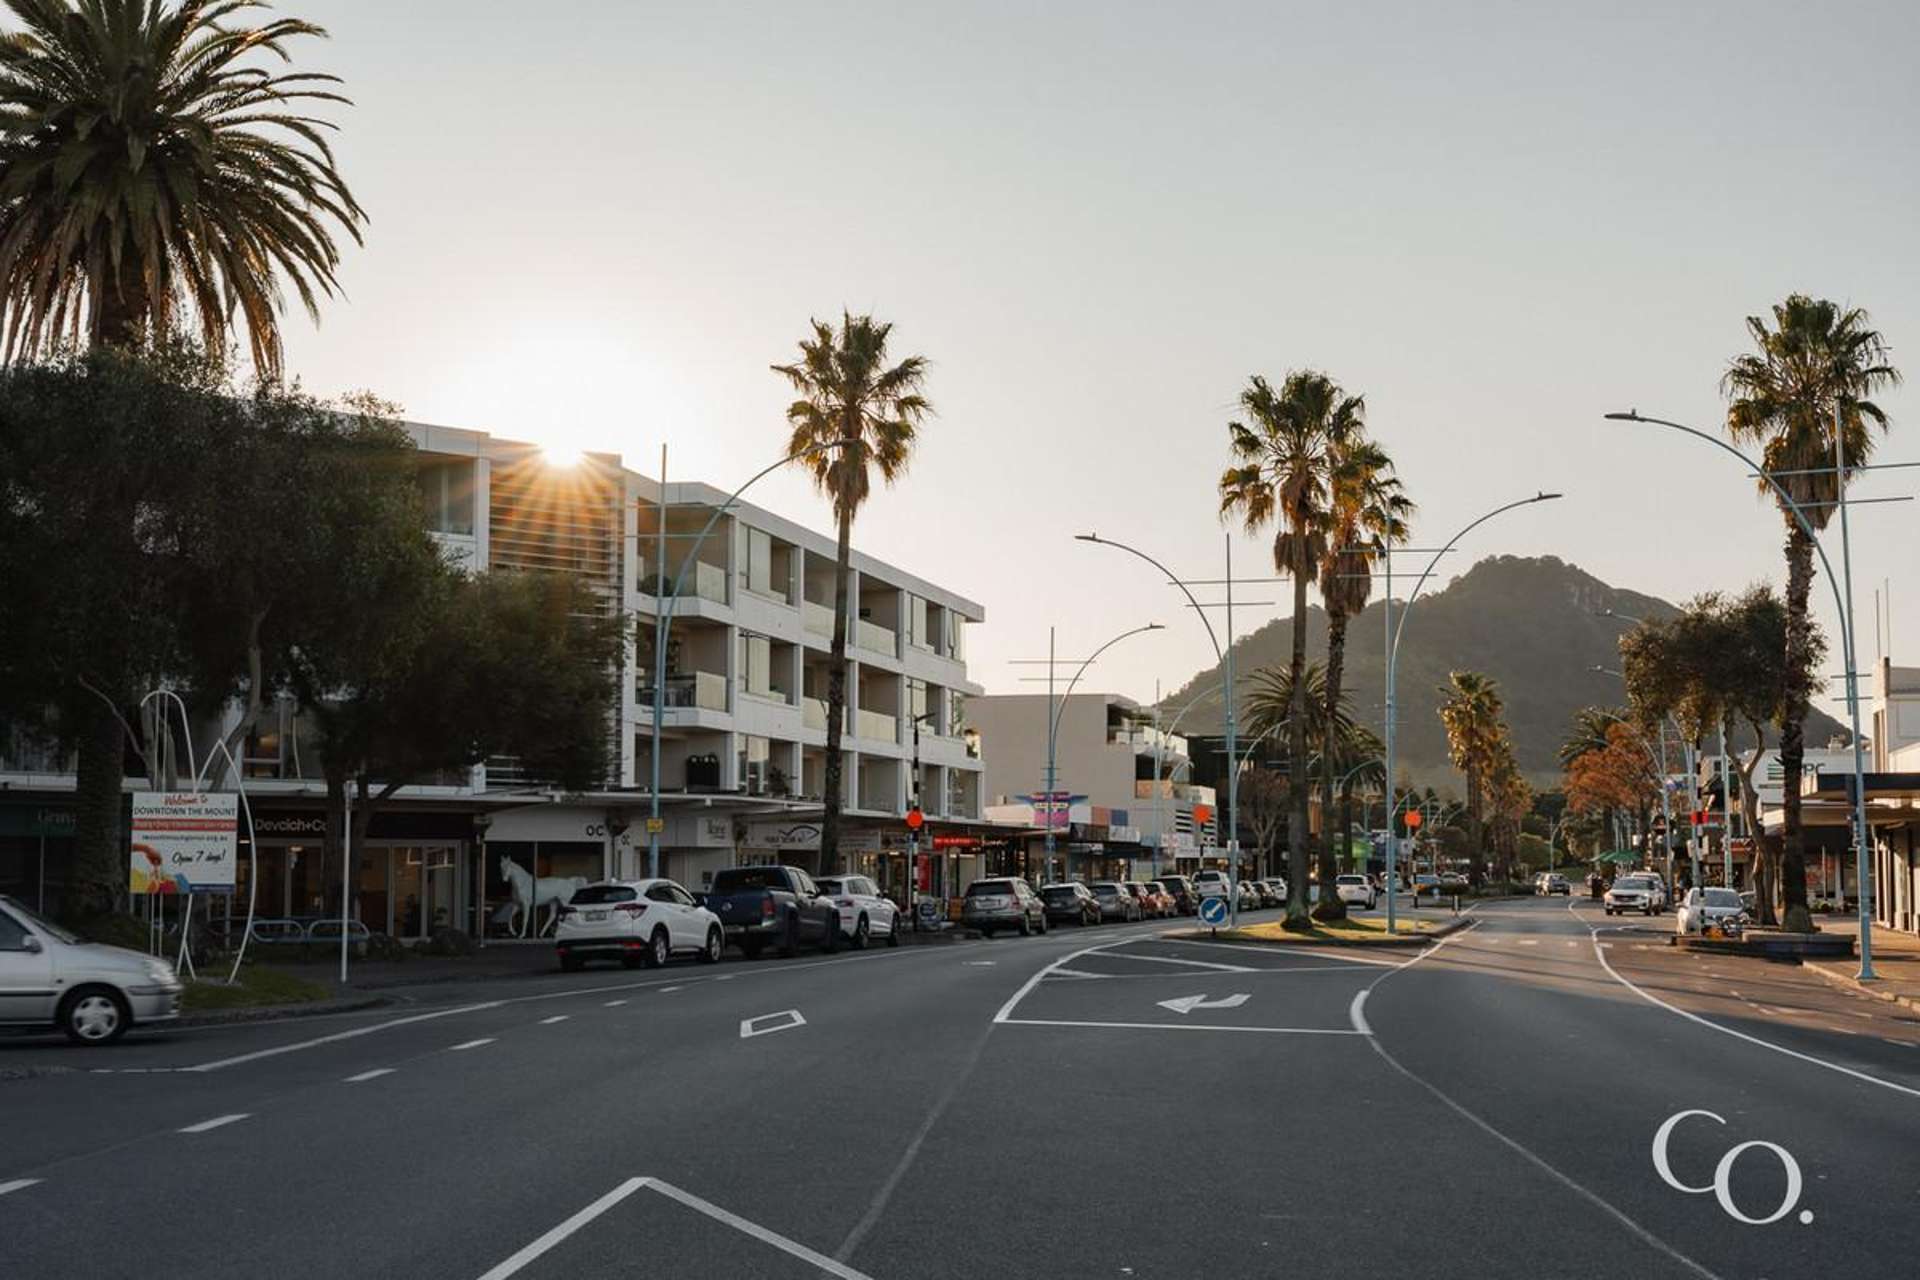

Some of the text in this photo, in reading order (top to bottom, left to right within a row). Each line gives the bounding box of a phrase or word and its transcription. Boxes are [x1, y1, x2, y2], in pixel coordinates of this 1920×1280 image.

[134, 806, 236, 817] DOWNTOWN THE MOUNT
